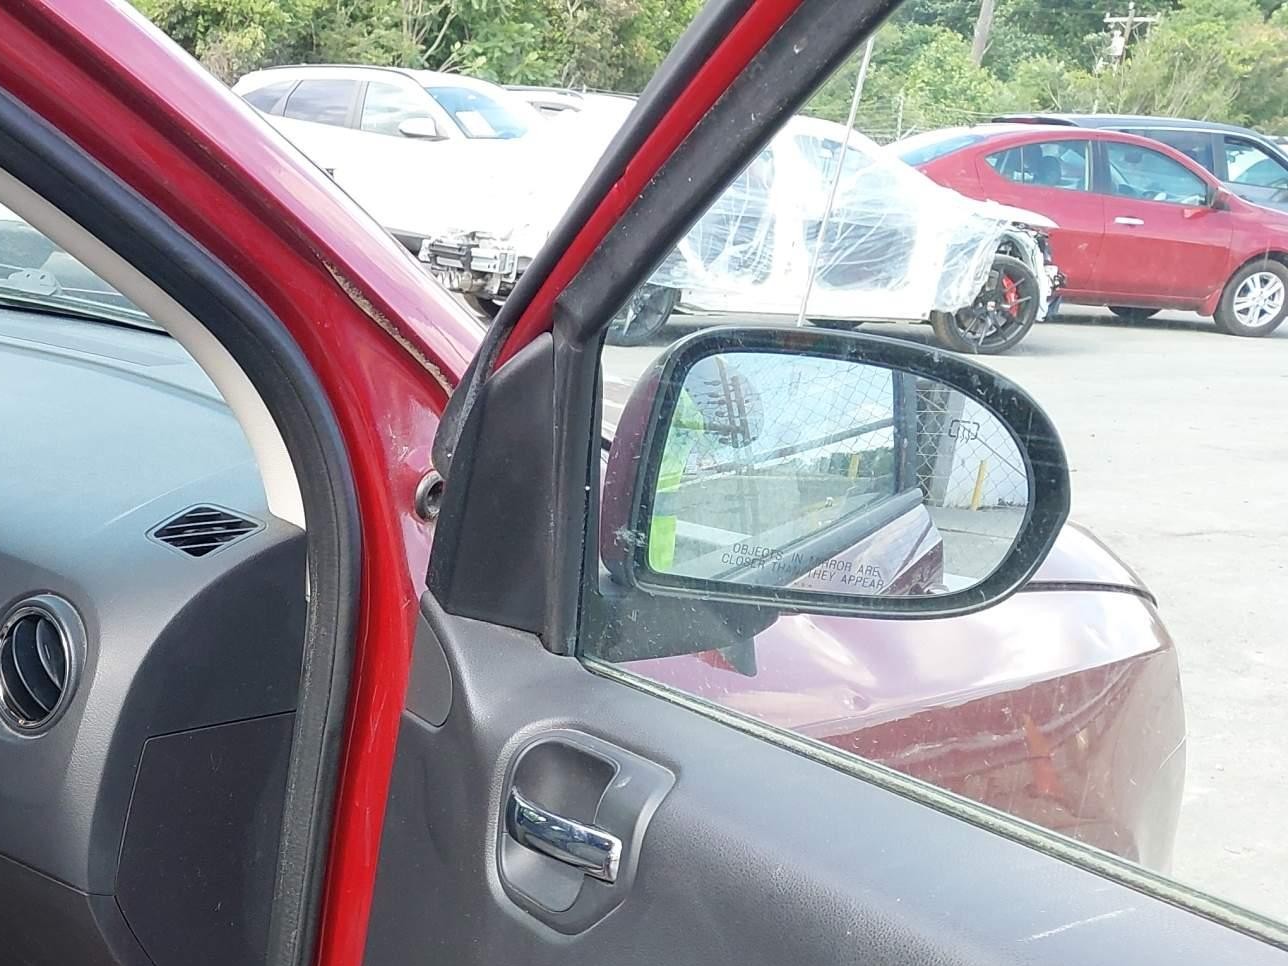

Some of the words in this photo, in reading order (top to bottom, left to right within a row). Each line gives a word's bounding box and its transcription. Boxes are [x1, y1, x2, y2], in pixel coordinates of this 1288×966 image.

[721, 553, 766, 569] CLOSER
[808, 569, 835, 582] THEY
[841, 574, 885, 589] APPEAR
[733, 542, 784, 561] OBJECTS
[792, 552, 804, 565] IN
[809, 555, 852, 572] RROR
[857, 564, 880, 578] ARE
